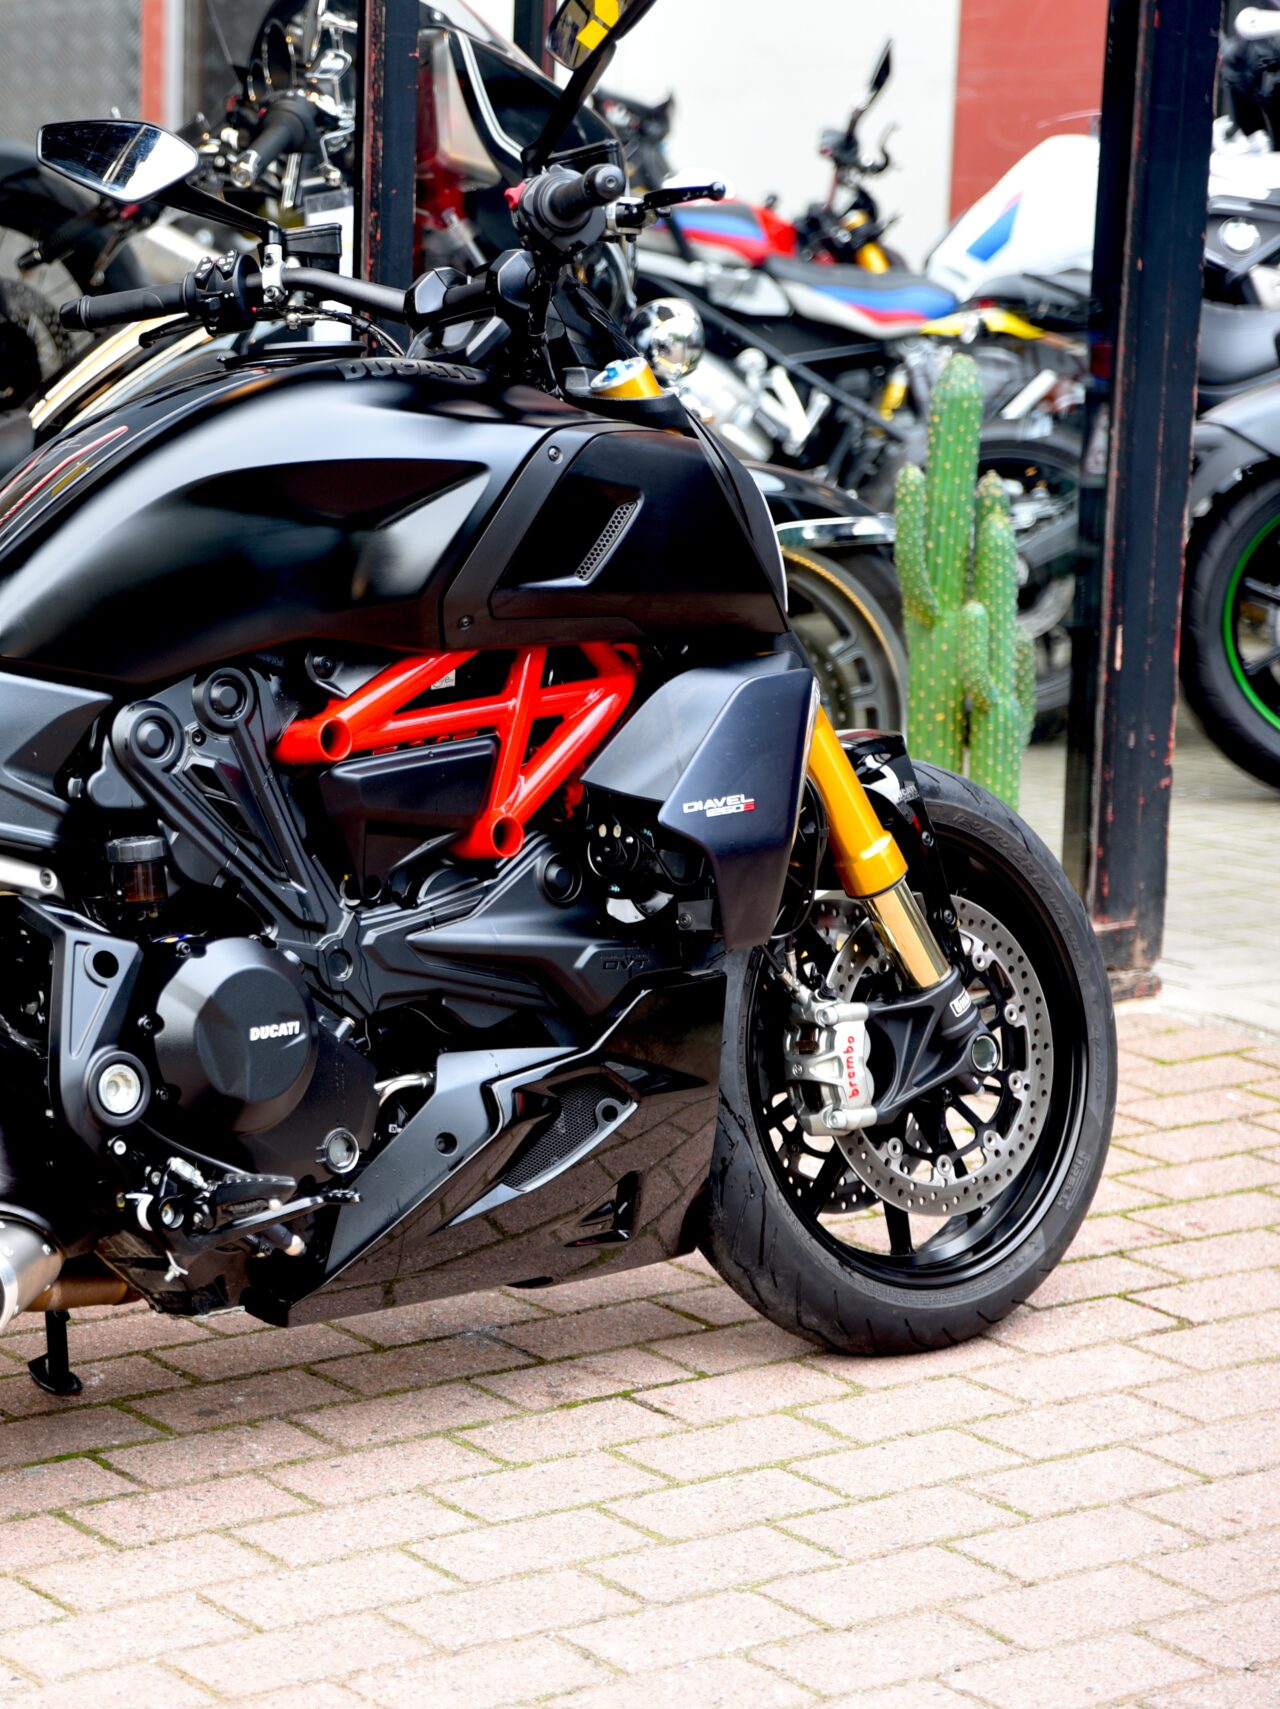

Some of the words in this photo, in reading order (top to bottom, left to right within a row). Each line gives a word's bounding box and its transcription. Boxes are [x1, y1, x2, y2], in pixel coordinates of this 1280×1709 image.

[334, 361, 477, 381] DUCATI
[682, 793, 755, 813] DIAVEL
[249, 1021, 300, 1041] DUCATI
[843, 1035, 860, 1099] brembo
